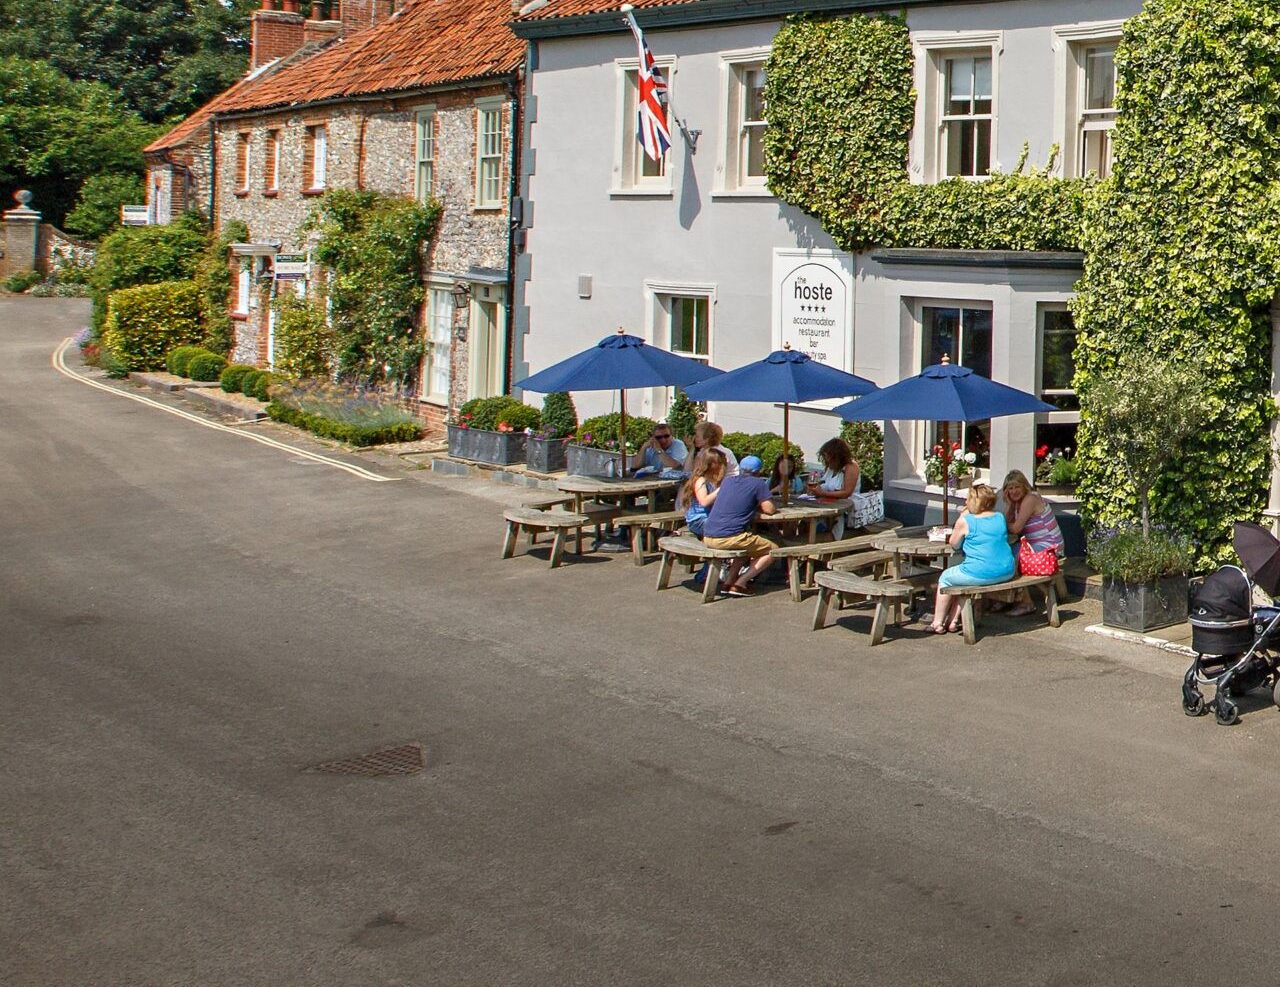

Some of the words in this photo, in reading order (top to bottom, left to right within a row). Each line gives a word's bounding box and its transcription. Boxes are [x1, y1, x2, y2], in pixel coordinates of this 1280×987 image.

[797, 276, 807, 284] the
[794, 281, 833, 301] hoste
[793, 316, 836, 327] accommodation
[798, 328, 831, 338] restaurant
[809, 337, 819, 348] bar
[817, 352, 827, 362] spa
